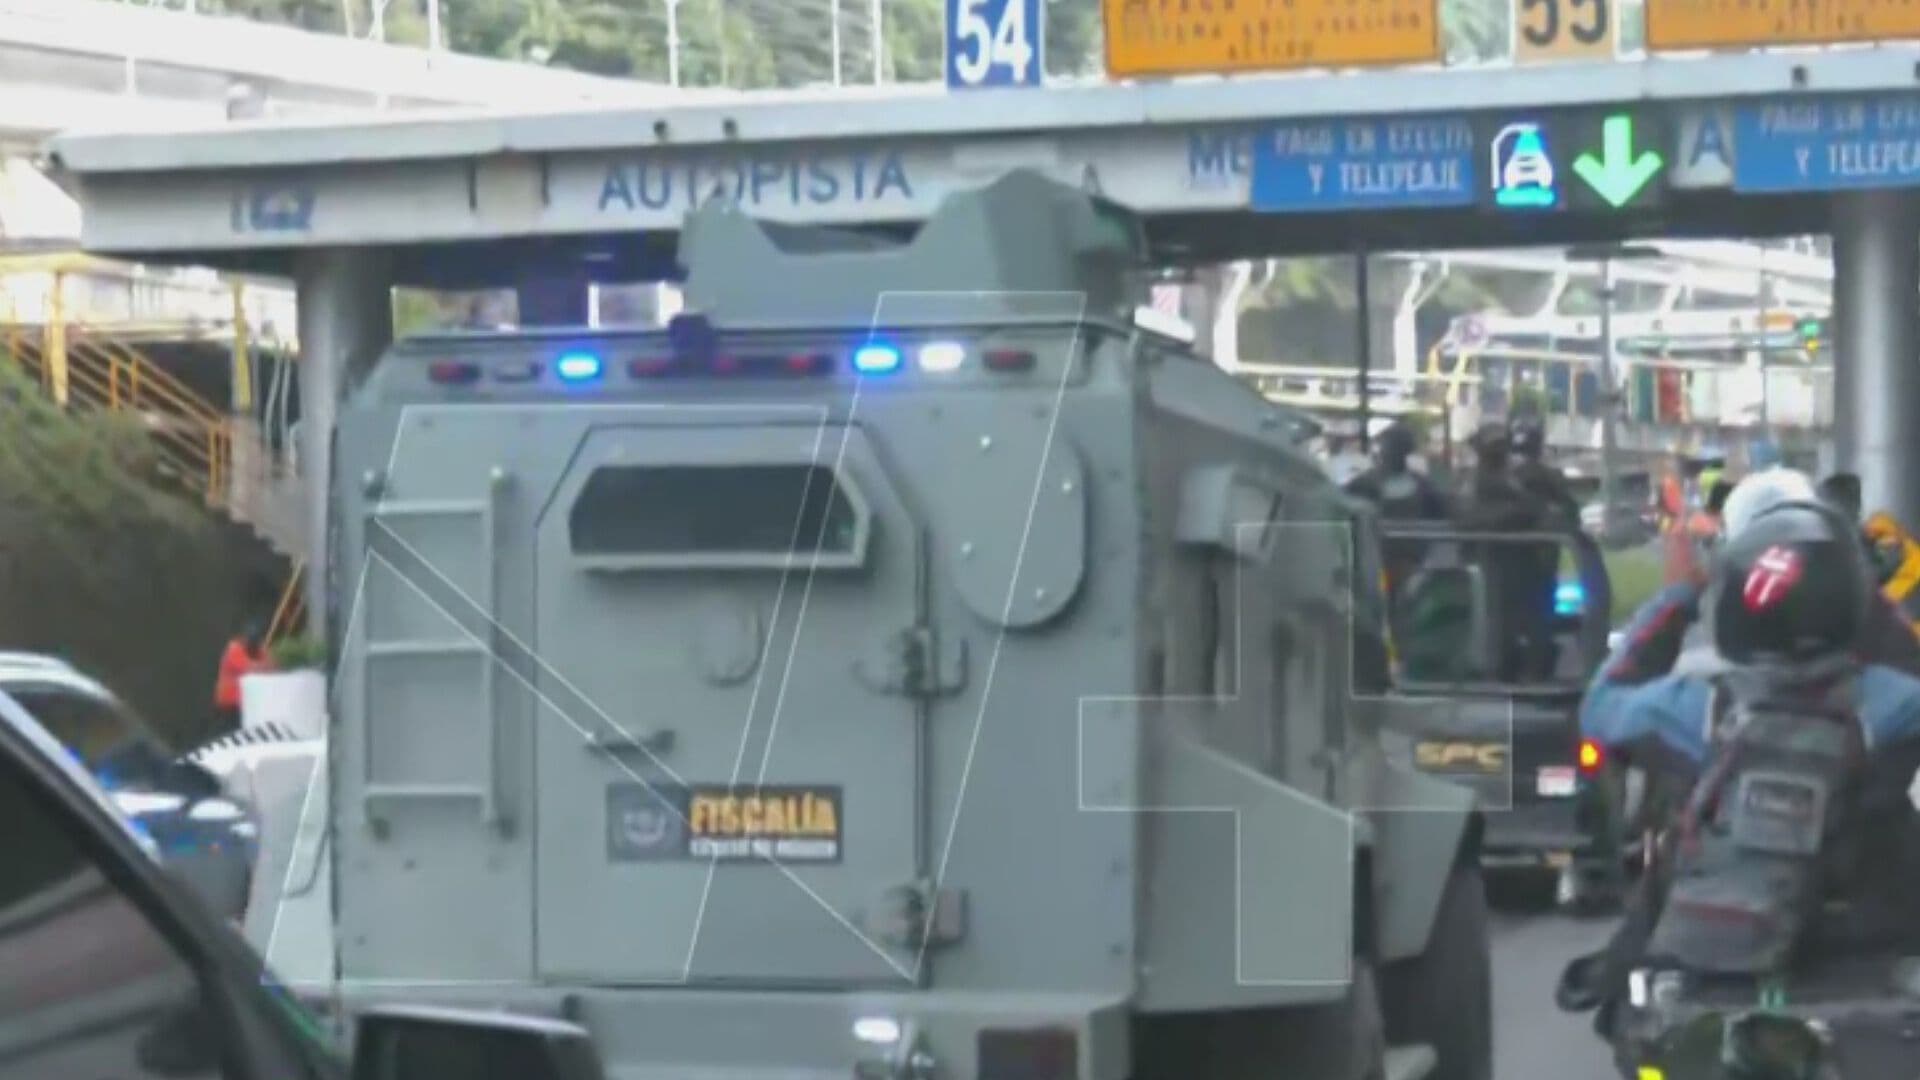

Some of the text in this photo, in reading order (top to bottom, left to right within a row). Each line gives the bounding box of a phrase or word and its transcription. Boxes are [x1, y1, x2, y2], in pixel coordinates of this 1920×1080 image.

[954, 0, 1033, 84] 54
[1308, 158, 1463, 195] Y TELEPEAJE
